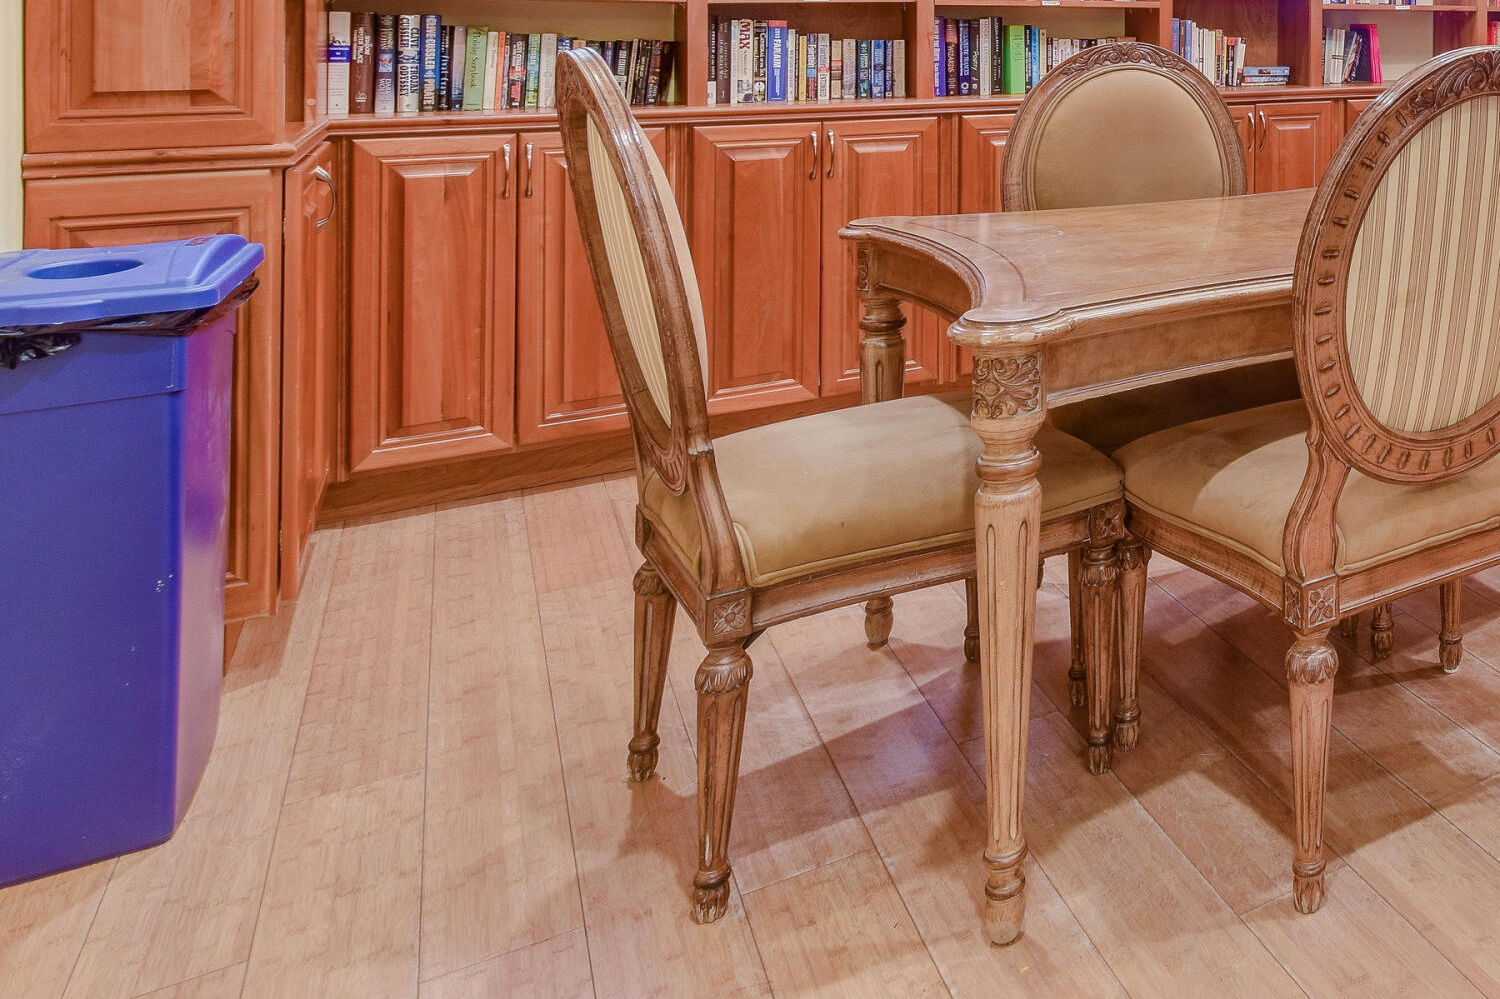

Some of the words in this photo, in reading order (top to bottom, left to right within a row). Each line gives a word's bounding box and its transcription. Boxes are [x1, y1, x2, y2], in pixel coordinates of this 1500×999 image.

[400, 18, 410, 48] CUSSLER
[410, 28, 419, 48] CLIVE
[425, 18, 436, 38] CLIVE
[740, 21, 751, 49] MAX
[424, 39, 436, 70] CUSSLER
[808, 45, 816, 67] Fairstein
[820, 45, 828, 67] Fairstein
[400, 65, 409, 97] ODYSSEY
[410, 65, 418, 93] TROJAN
[469, 57, 478, 88] Storybook
[424, 79, 435, 105] PIRATE
